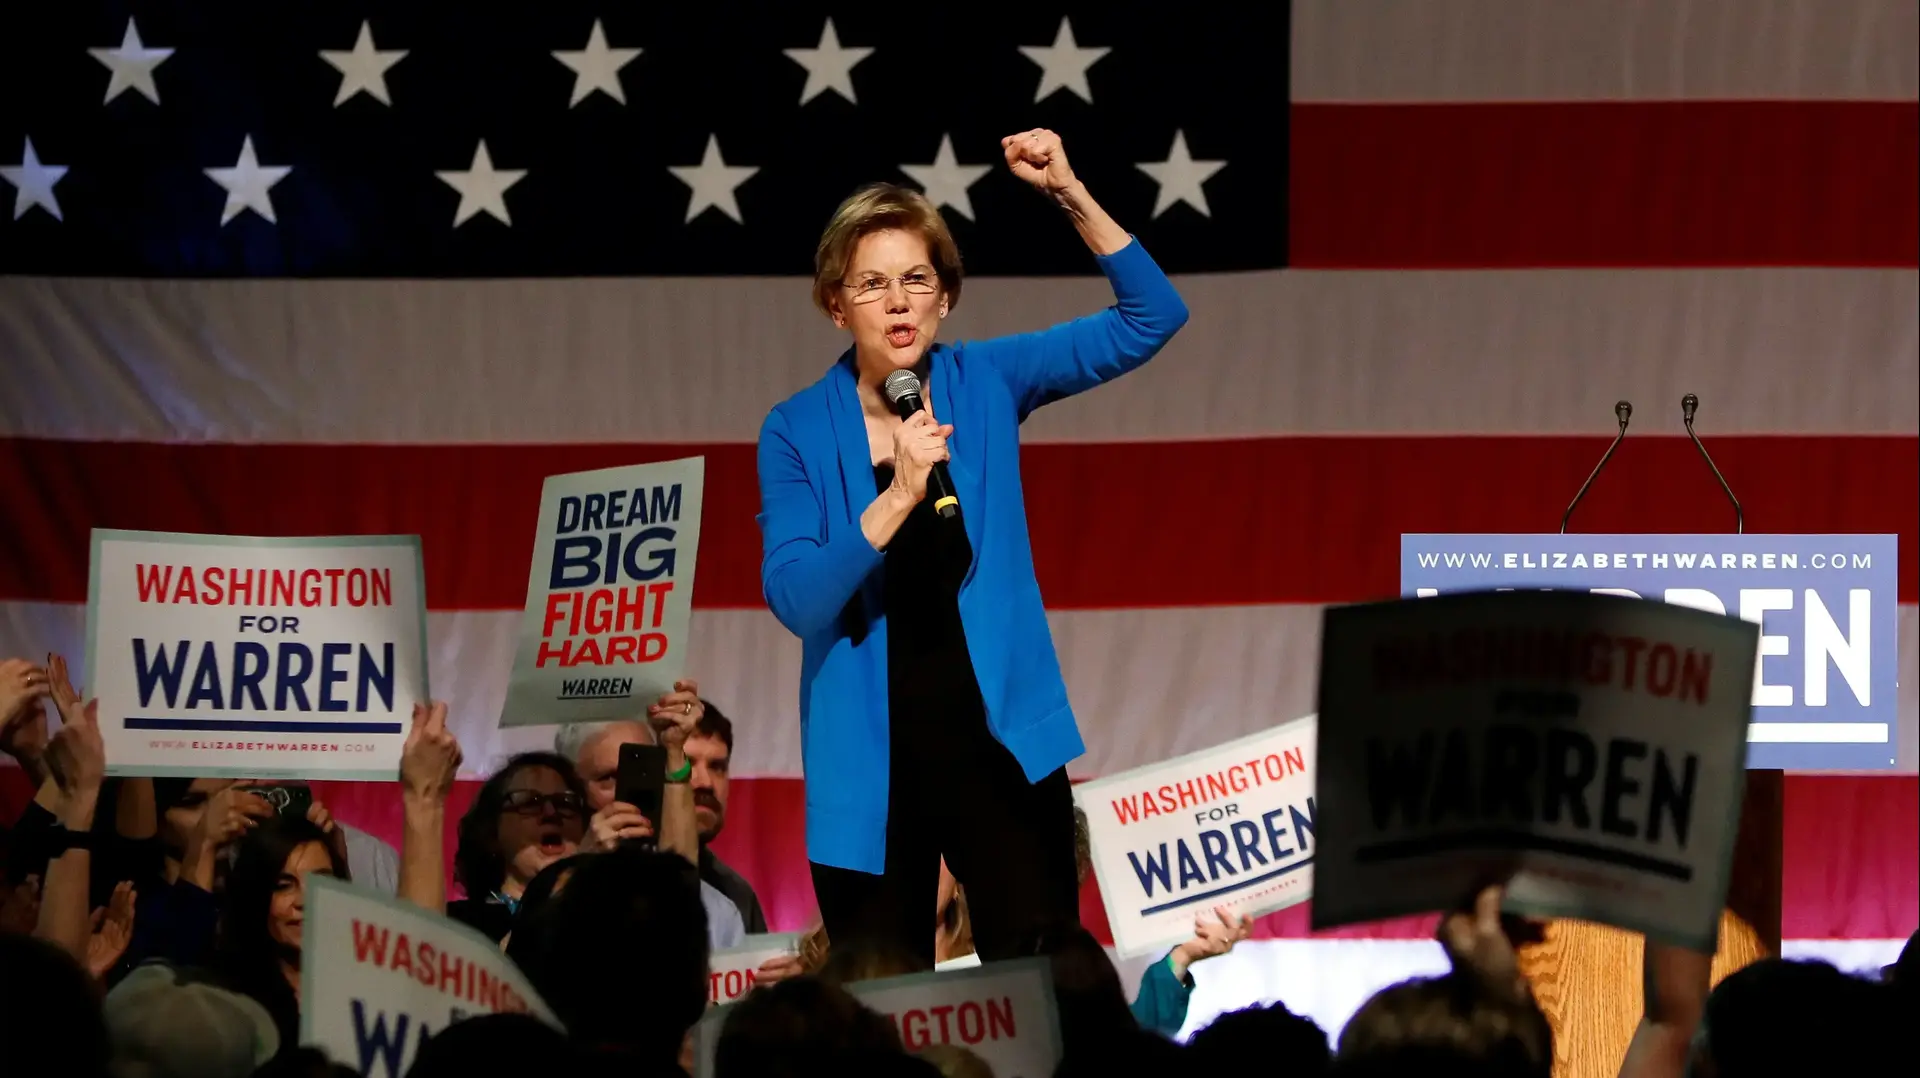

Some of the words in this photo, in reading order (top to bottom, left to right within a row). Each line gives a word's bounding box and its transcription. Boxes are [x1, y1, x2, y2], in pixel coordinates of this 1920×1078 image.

[556, 483, 682, 534] DREAM
[549, 527, 677, 589] BIG
[1417, 553, 1872, 569] WWW.ELIZABETHWARREN.COM
[136, 563, 393, 607] WASHINGTON
[542, 582, 675, 637] FIGHT
[239, 615, 300, 634] FOR
[131, 638, 395, 713] WARREN
[535, 632, 669, 669] HARD
[561, 677, 634, 696] WARREN
[1111, 746, 1306, 826] WASHINGTON
[1366, 717, 1698, 848] WARREN
[1194, 803, 1242, 826] FOR
[1126, 796, 1317, 899] WARREN
